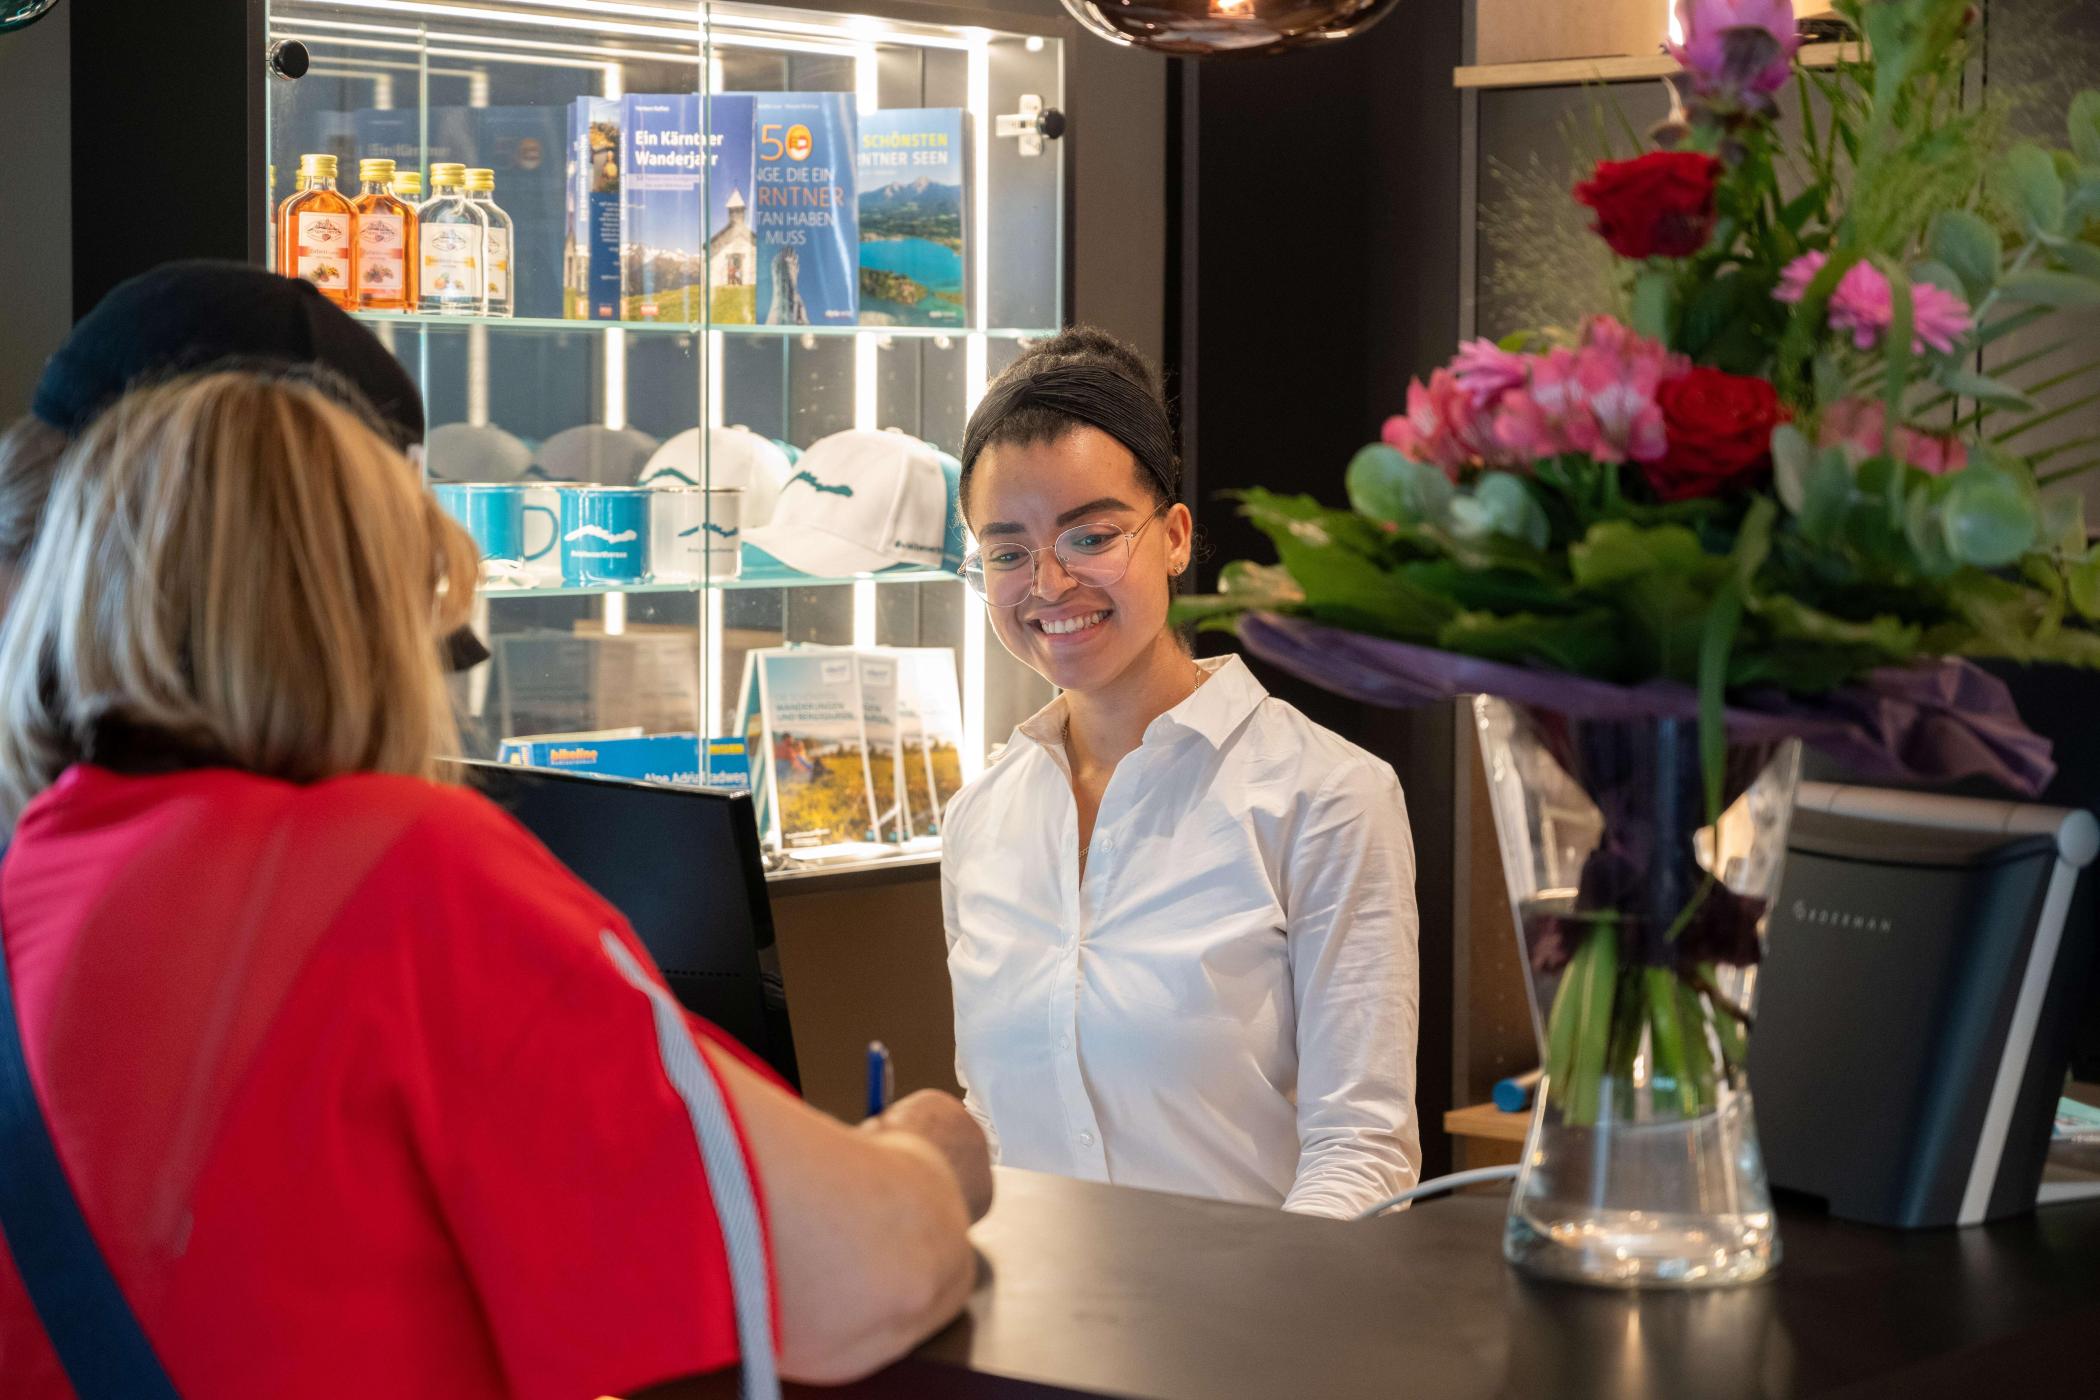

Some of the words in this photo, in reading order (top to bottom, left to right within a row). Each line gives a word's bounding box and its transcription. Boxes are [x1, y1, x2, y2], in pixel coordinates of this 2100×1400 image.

[635, 131, 658, 145] Ein
[660, 131, 724, 146] Kärntner
[760, 124, 813, 161] 50
[863, 131, 948, 148] SCHÖNSTEN
[635, 151, 719, 169] Wanderjahr
[911, 151, 949, 166] SEEN
[786, 167, 809, 182] DIE
[786, 211, 833, 226] HABEN
[764, 229, 807, 245] MUSS
